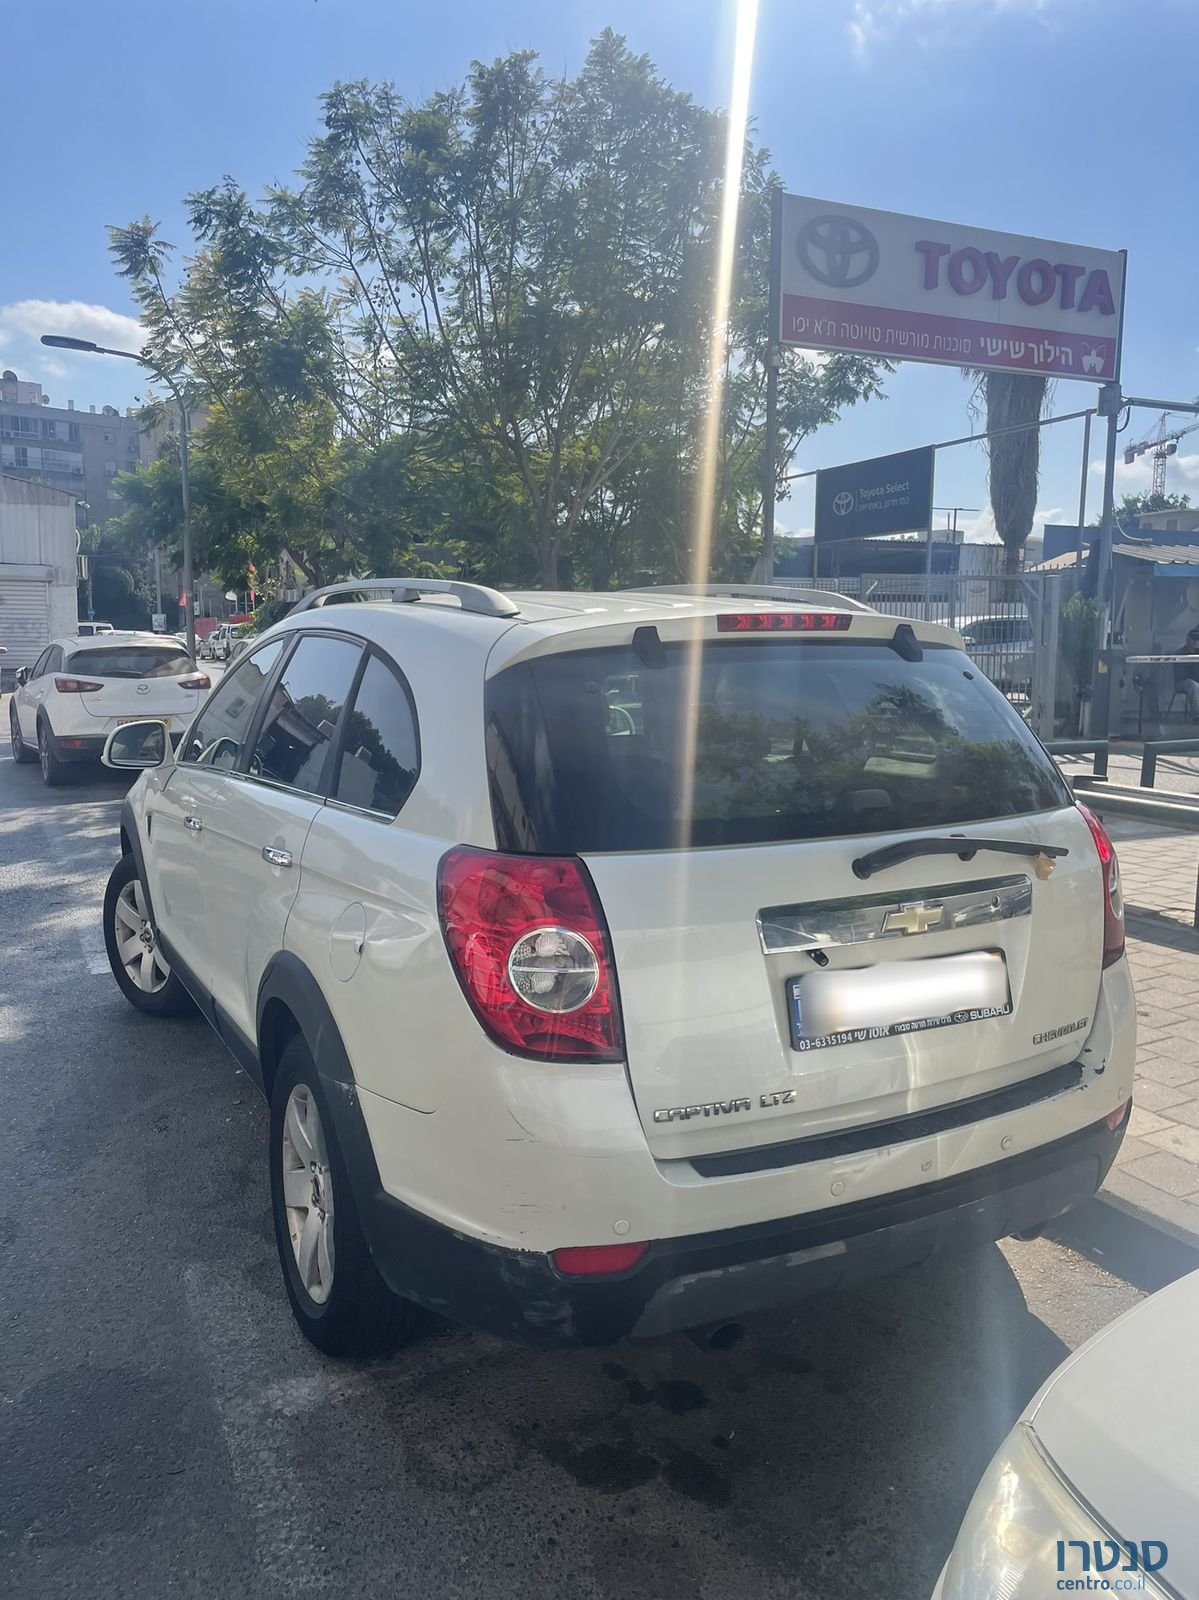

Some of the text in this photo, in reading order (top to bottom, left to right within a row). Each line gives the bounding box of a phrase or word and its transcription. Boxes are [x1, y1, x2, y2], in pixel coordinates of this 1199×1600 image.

[914, 239, 1116, 316] TOYOTA
[792, 316, 810, 332] יפו
[840, 322, 881, 343] טויוטה
[885, 329, 930, 349] מורשית
[933, 335, 971, 354] סוכנות
[980, 336, 1025, 359] שישי
[1027, 339, 1073, 366] הילוך
[860, 481, 910, 500] Toyota Select
[970, 1005, 1010, 1020] SUBARU
[854, 1028, 867, 1041] שי
[869, 1025, 890, 1039] אוטו
[1032, 1016, 1089, 1045] CHEVROLET
[800, 1032, 853, 1050] 03-6335194
[653, 1089, 797, 1123] CAPTIVA LTZ
